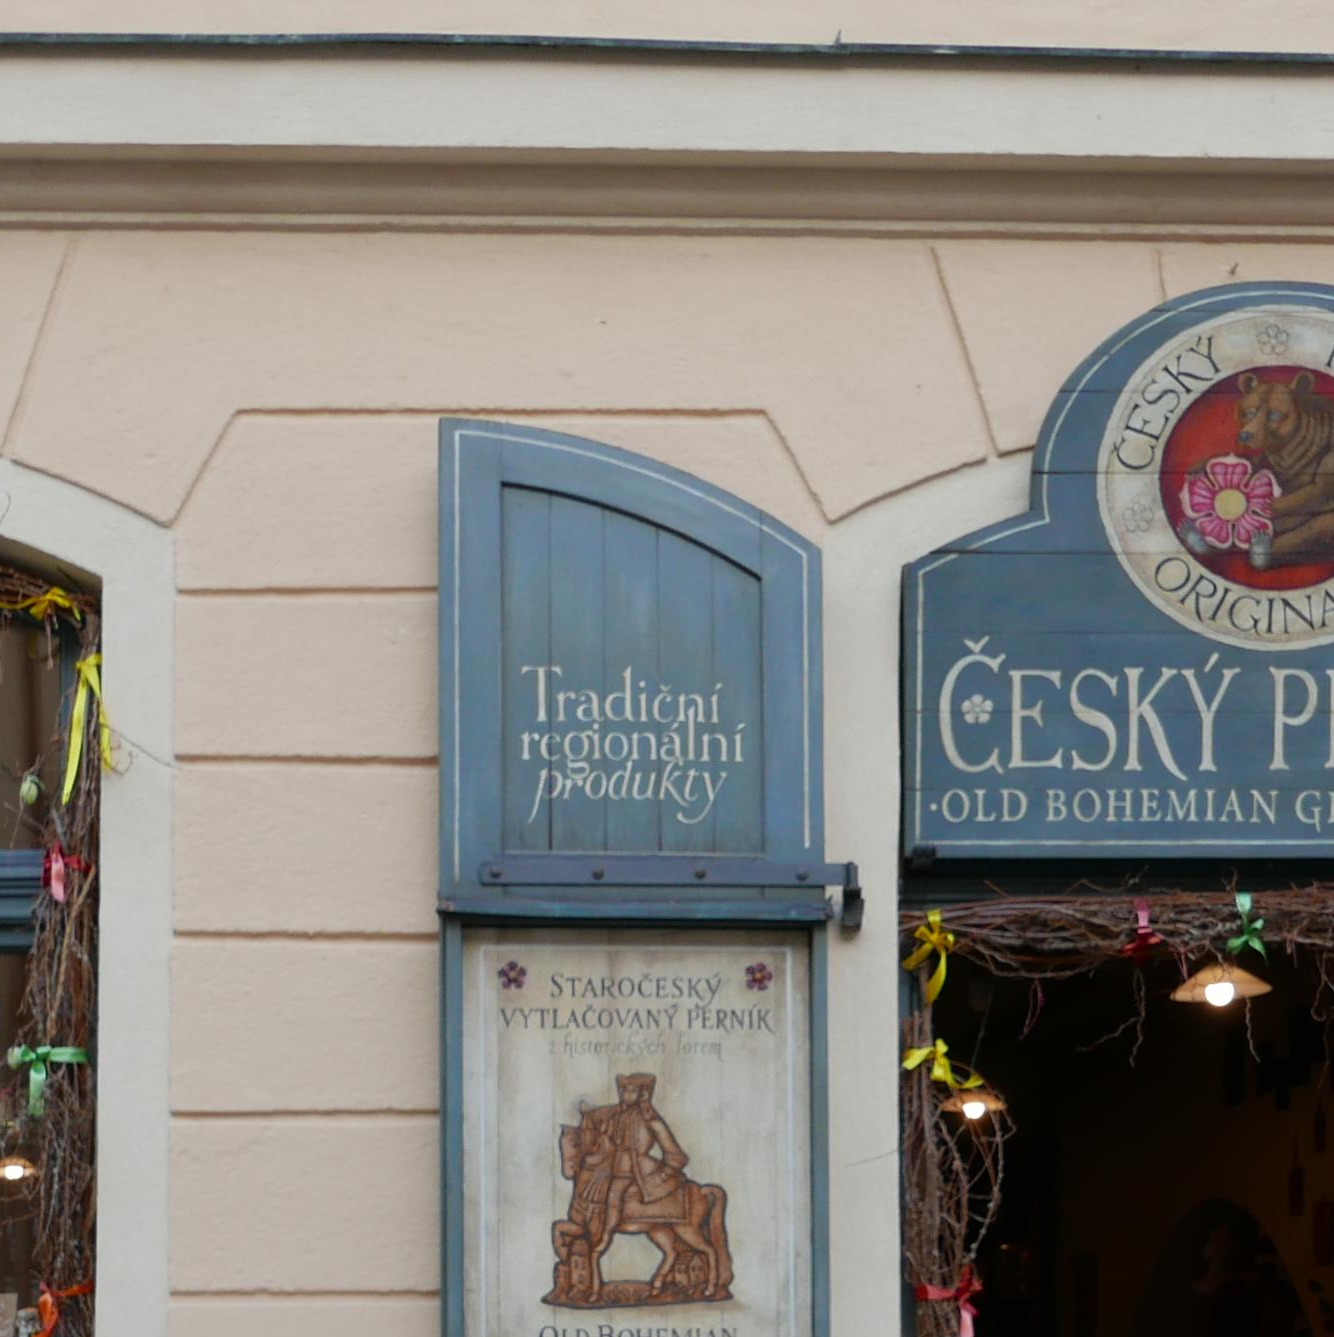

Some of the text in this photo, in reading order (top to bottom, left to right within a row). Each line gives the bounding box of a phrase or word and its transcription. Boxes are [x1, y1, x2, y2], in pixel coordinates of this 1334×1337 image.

[1111, 336, 1223, 471] ČESKÝ
[521, 665, 723, 723] Tradiční
[938, 636, 1240, 781] ČESKÝ
[521, 706, 746, 780] regionální
[528, 758, 727, 824] produkty
[942, 789, 1028, 824] OLD
[1047, 789, 1278, 824] BOHEMIAN
[499, 1001, 777, 1034] VYTLAČOVANÝ PERNÍK
